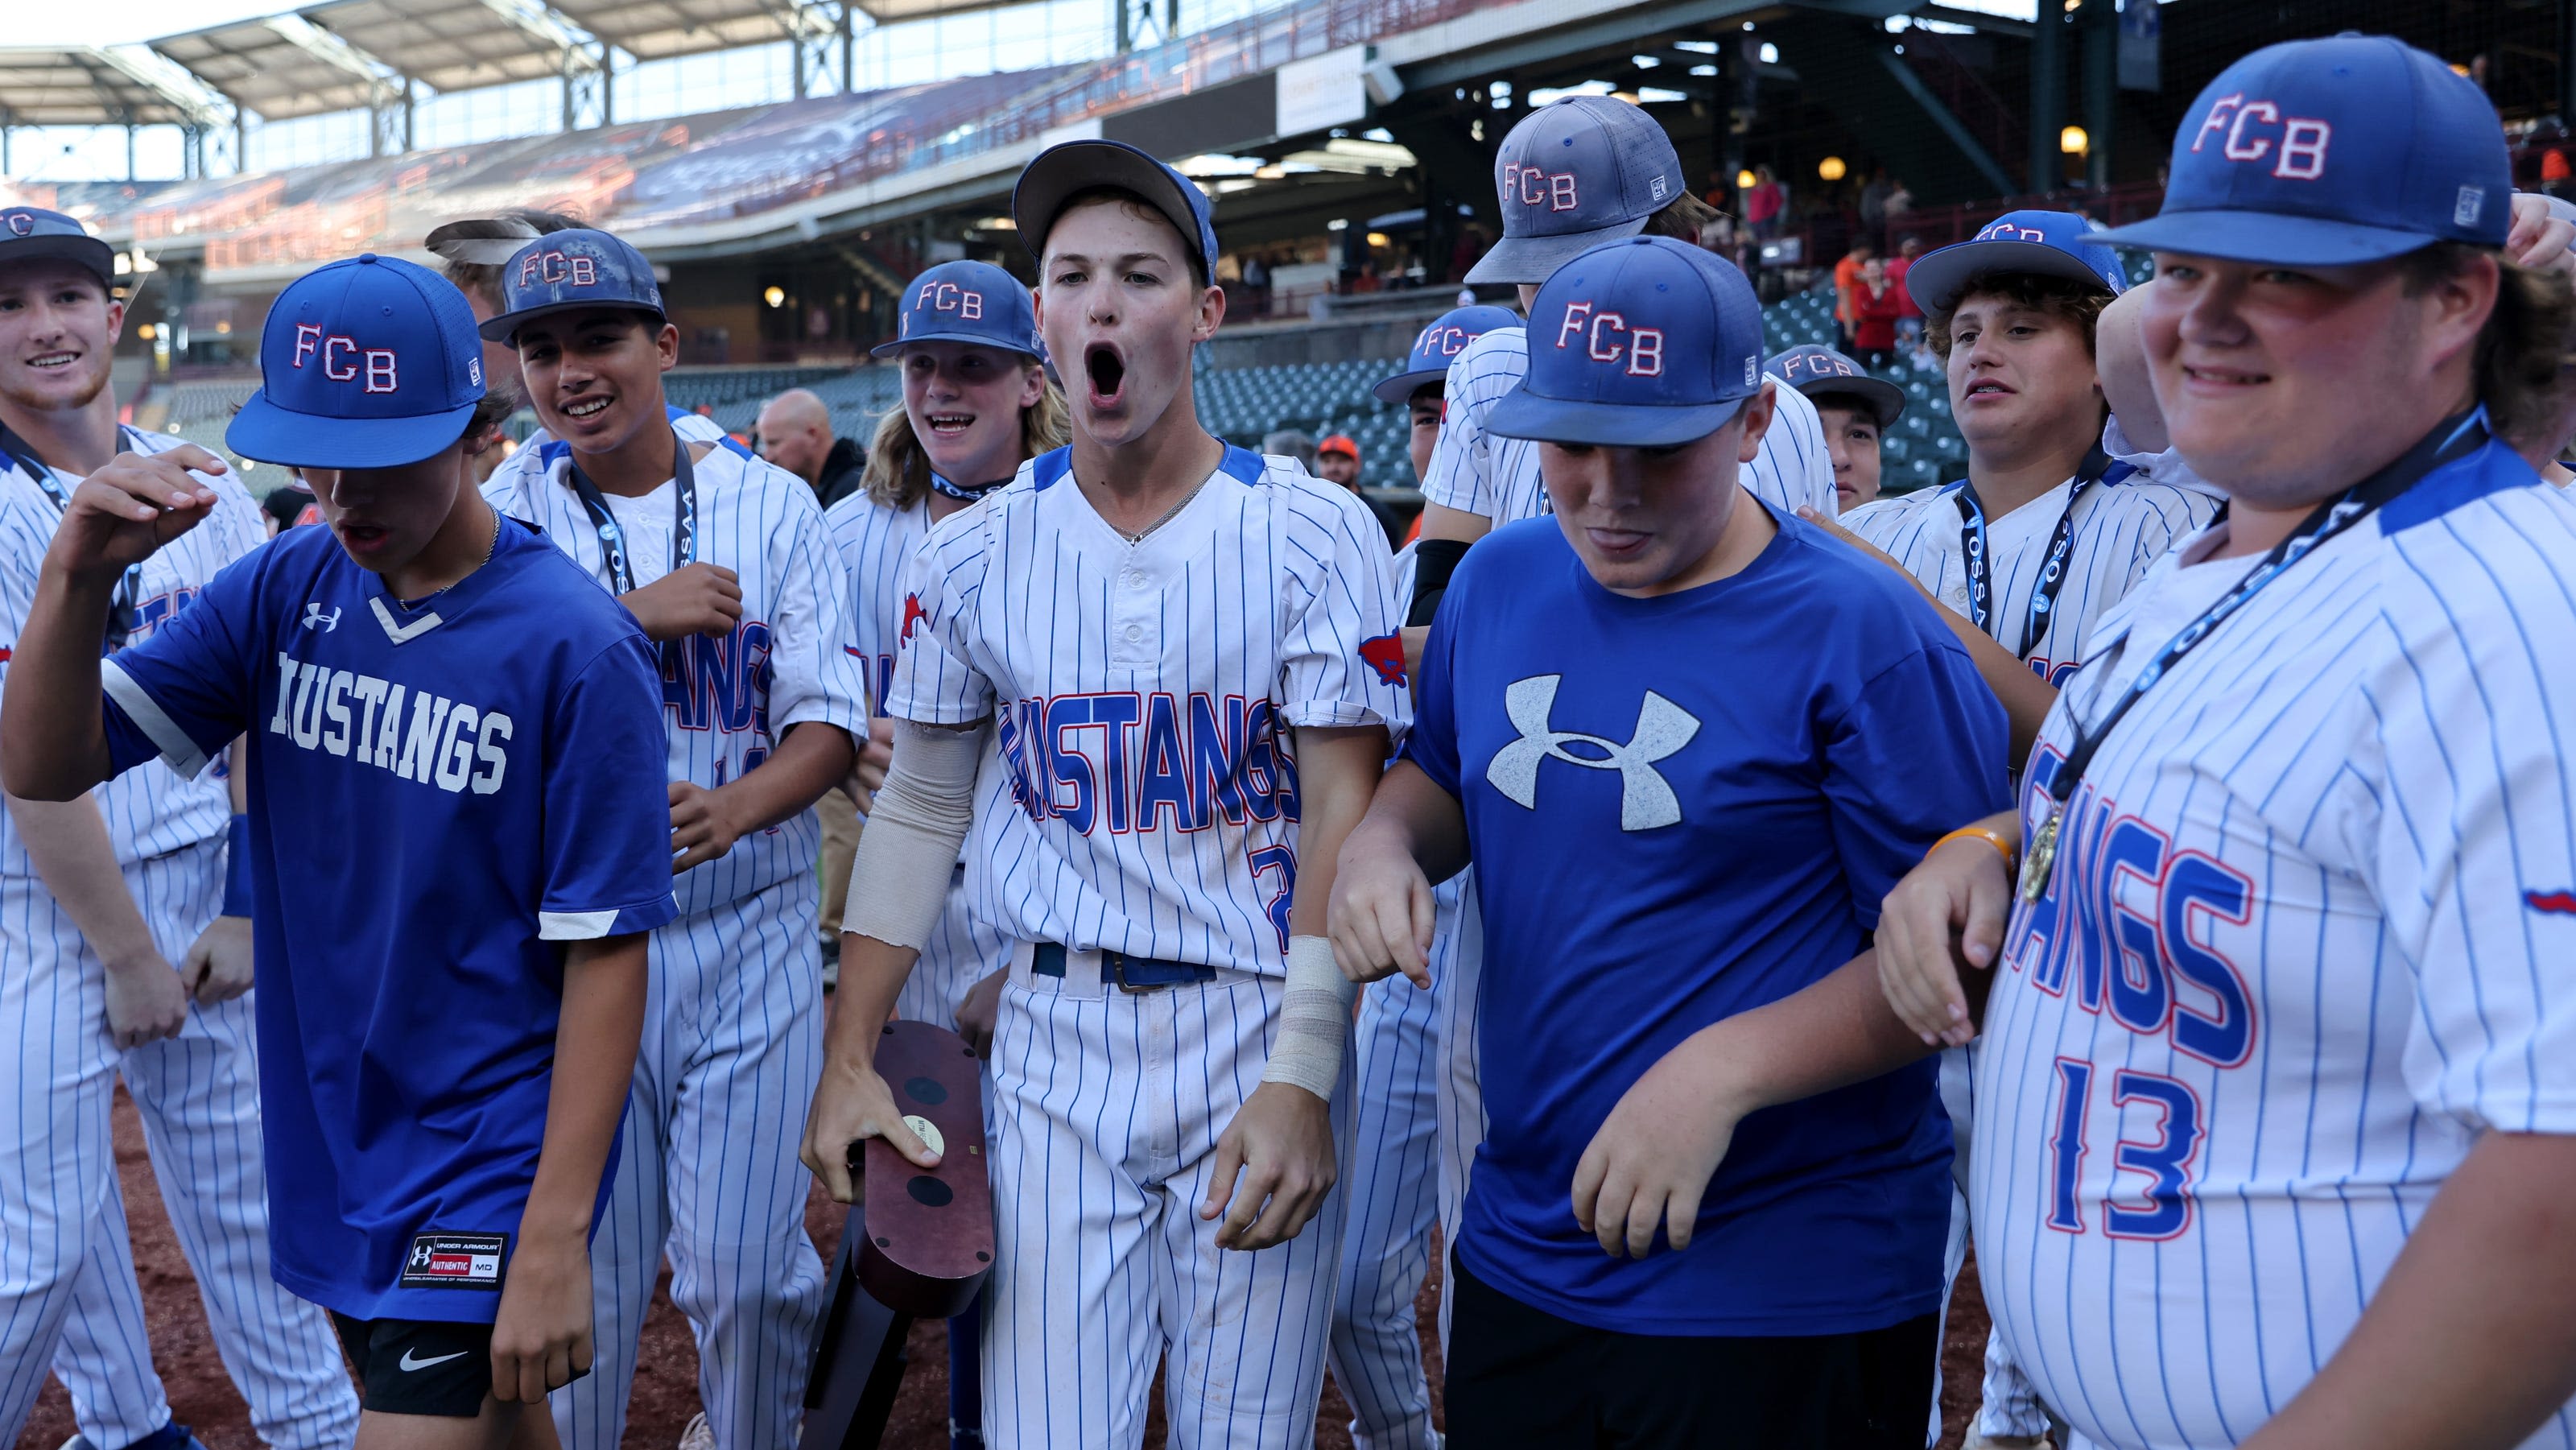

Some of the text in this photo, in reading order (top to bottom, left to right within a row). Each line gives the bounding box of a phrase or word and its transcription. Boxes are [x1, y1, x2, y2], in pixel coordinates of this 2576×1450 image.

[2190, 93, 2331, 180] FCB
[1504, 162, 1579, 212] FCB
[519, 250, 597, 287] FCB
[914, 280, 984, 320] FCB
[292, 322, 399, 394] FCB
[1555, 300, 1665, 378] FCB
[2046, 1055, 2207, 1242] 13
[431, 1261, 493, 1271] AUTHENTIC MD
[462, 1242, 497, 1250] ARMOUR
